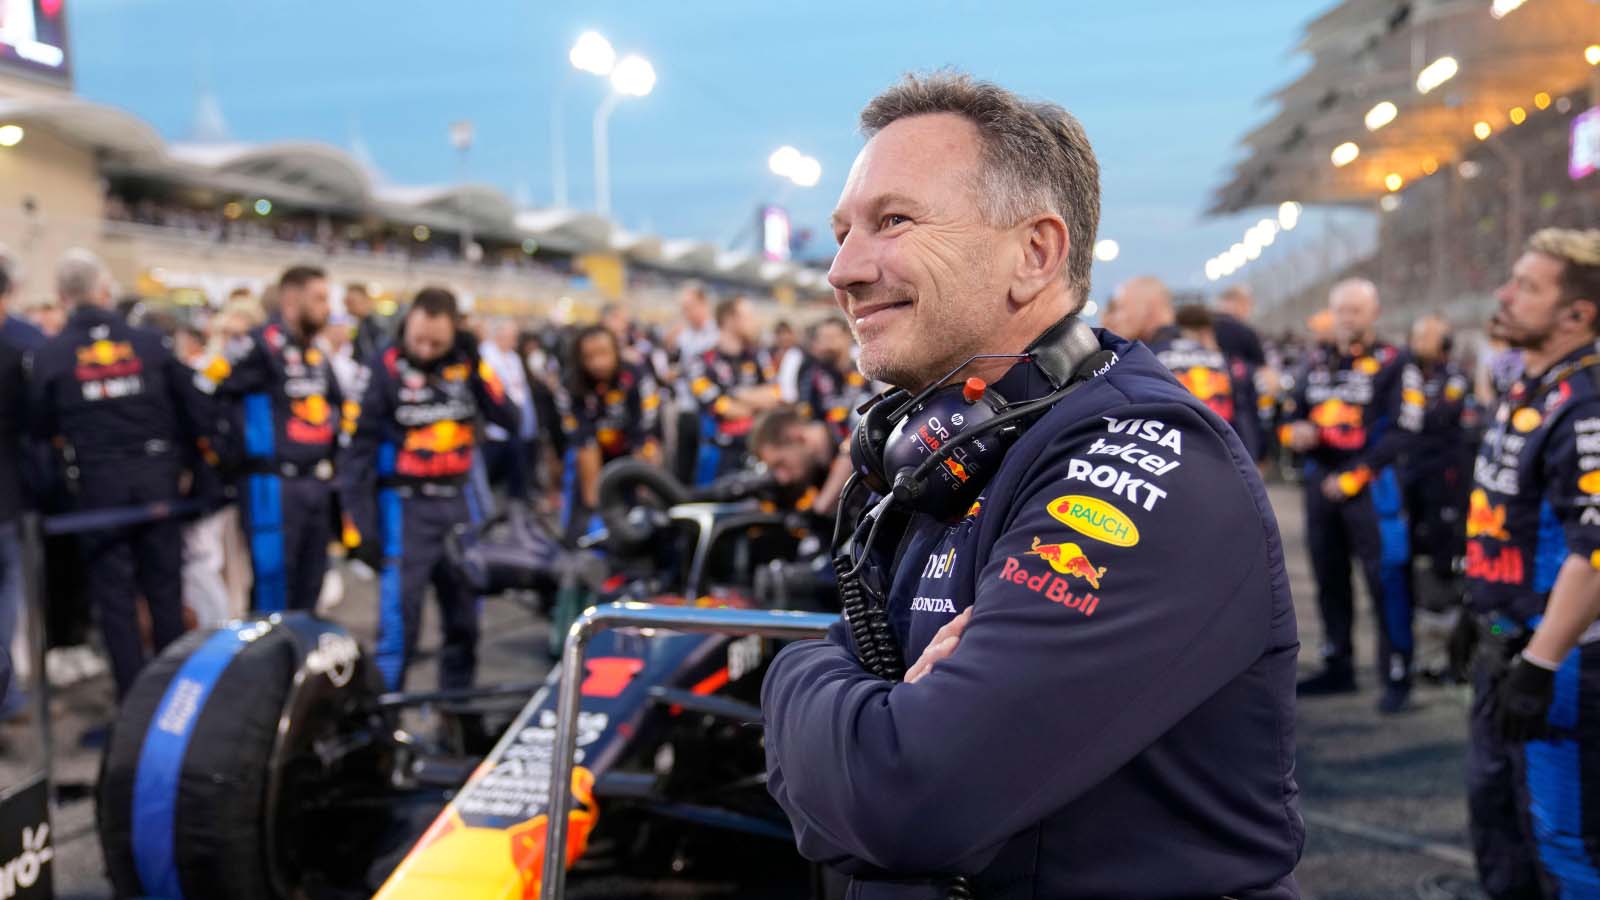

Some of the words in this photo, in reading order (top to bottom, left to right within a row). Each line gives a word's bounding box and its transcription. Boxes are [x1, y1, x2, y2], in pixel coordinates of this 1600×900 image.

[928, 416, 977, 474] ORCLE
[972, 438, 987, 453] poly
[1086, 438, 1180, 476] telcel
[1102, 416, 1182, 455] VISA
[909, 433, 960, 490] RAING
[1063, 458, 1167, 512] ROKT
[1069, 503, 1130, 541] RAUCH
[1000, 556, 1052, 593] Red
[1044, 576, 1100, 617] Bull
